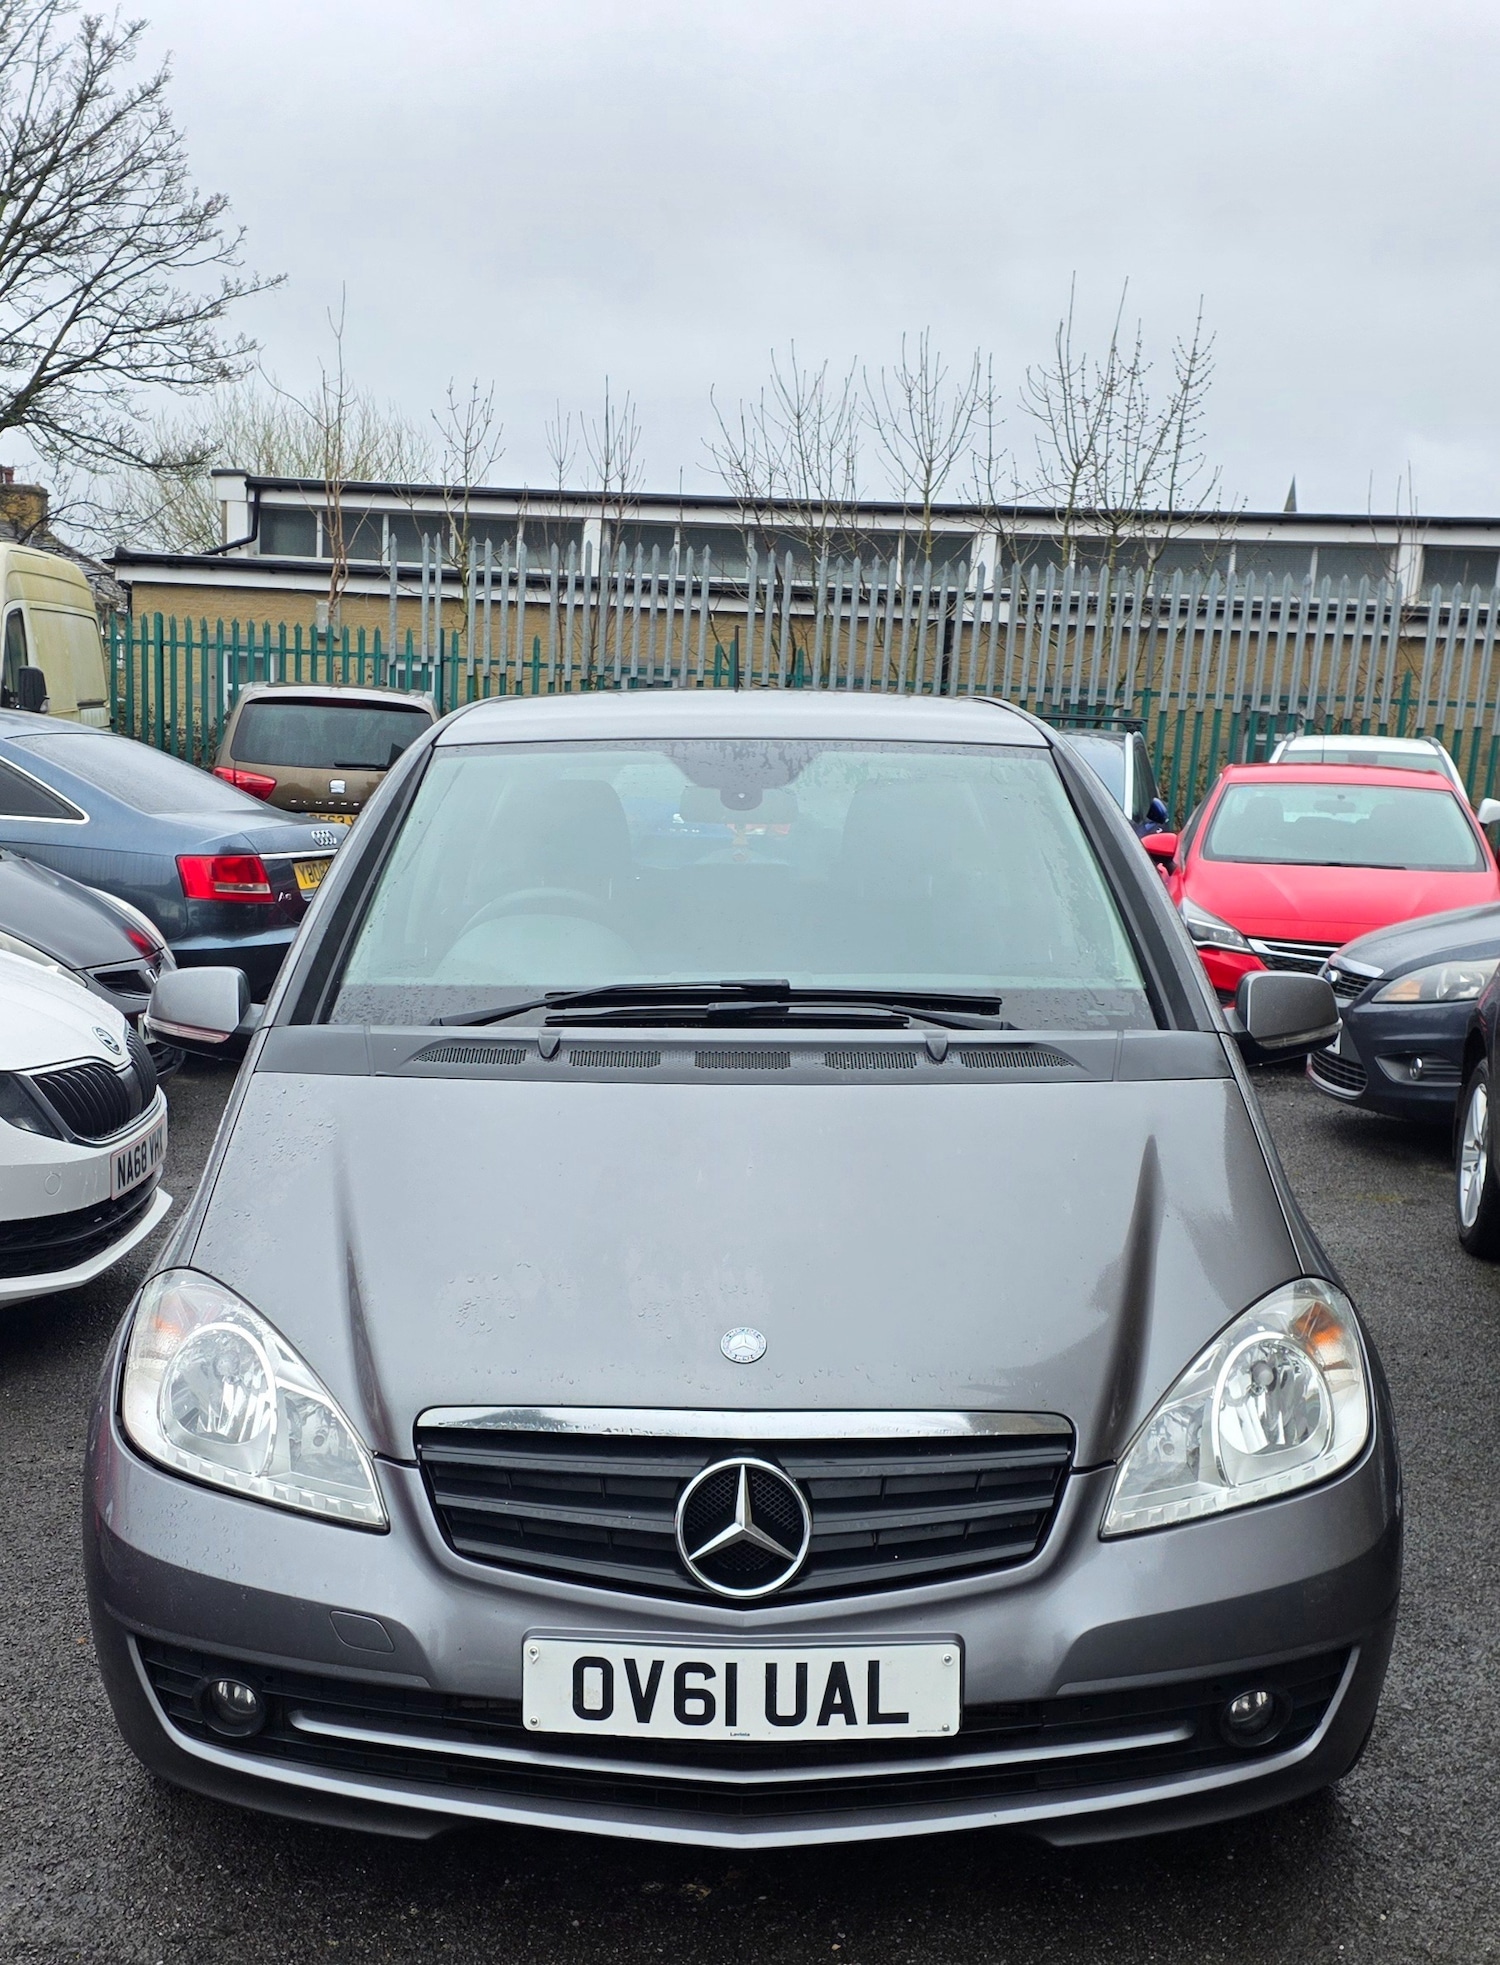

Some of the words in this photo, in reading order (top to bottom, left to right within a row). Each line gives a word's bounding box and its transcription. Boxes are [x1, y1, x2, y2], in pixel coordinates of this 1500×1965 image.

[118, 1141, 147, 1190] NA68
[572, 1656, 738, 1727] OV61
[765, 1660, 910, 1727] UAL
